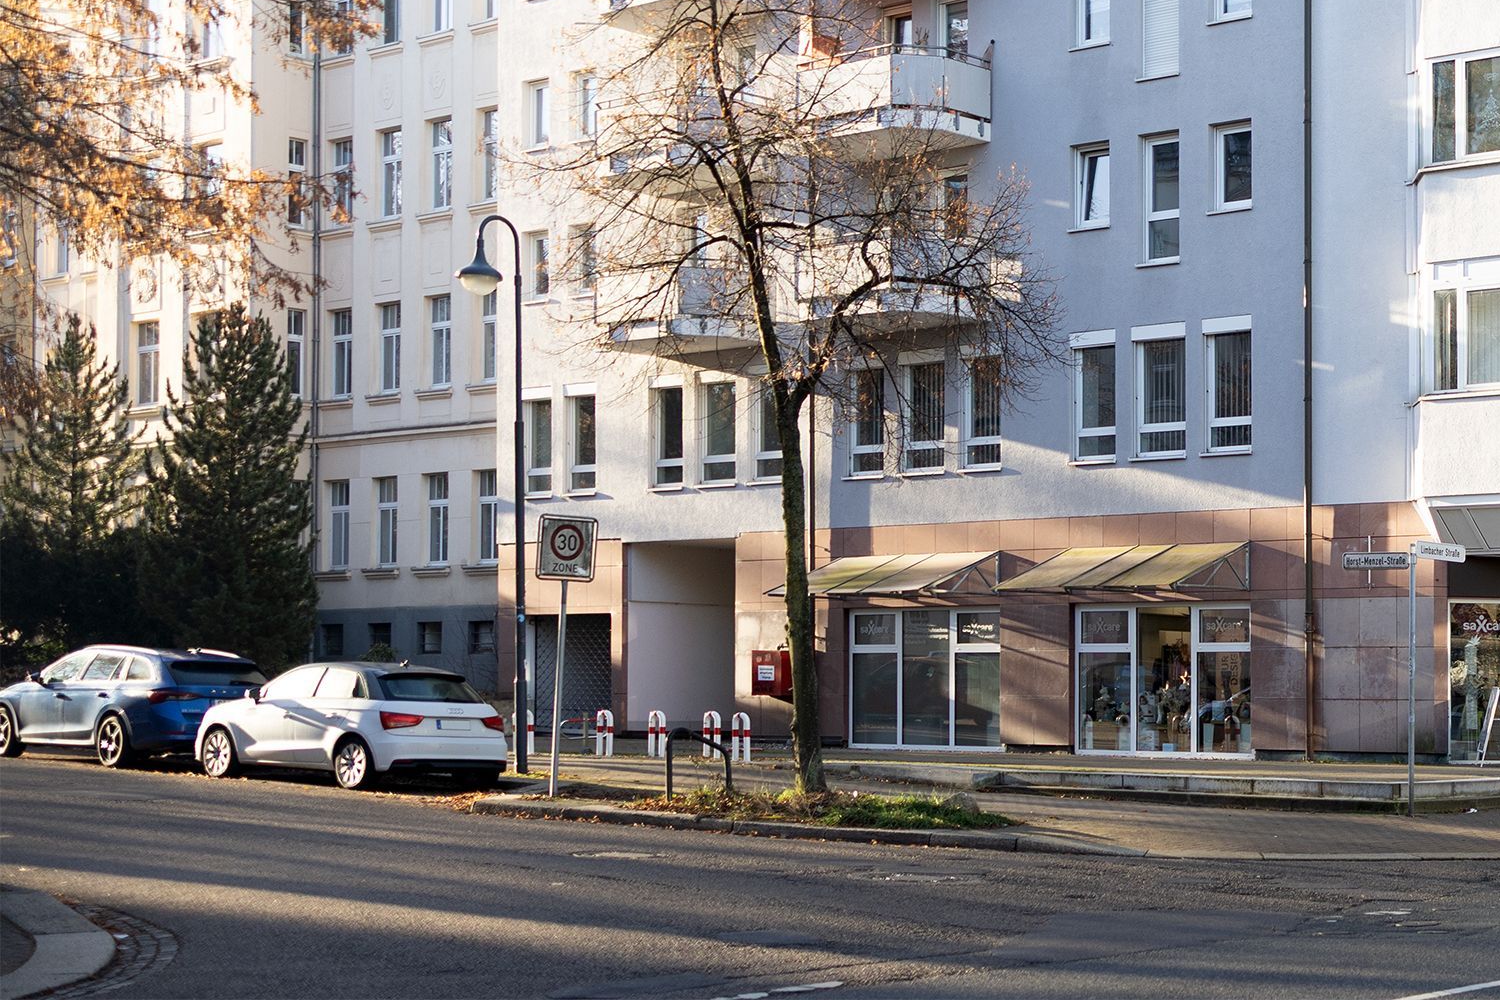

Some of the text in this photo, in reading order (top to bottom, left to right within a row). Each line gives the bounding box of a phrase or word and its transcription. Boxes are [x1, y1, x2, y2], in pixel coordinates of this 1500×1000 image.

[557, 534, 577, 551] 30
[1420, 545, 1460, 558] Limbacher Straße
[1346, 556, 1406, 566] Horst-Menzel-Straße
[552, 563, 578, 573] ZONE
